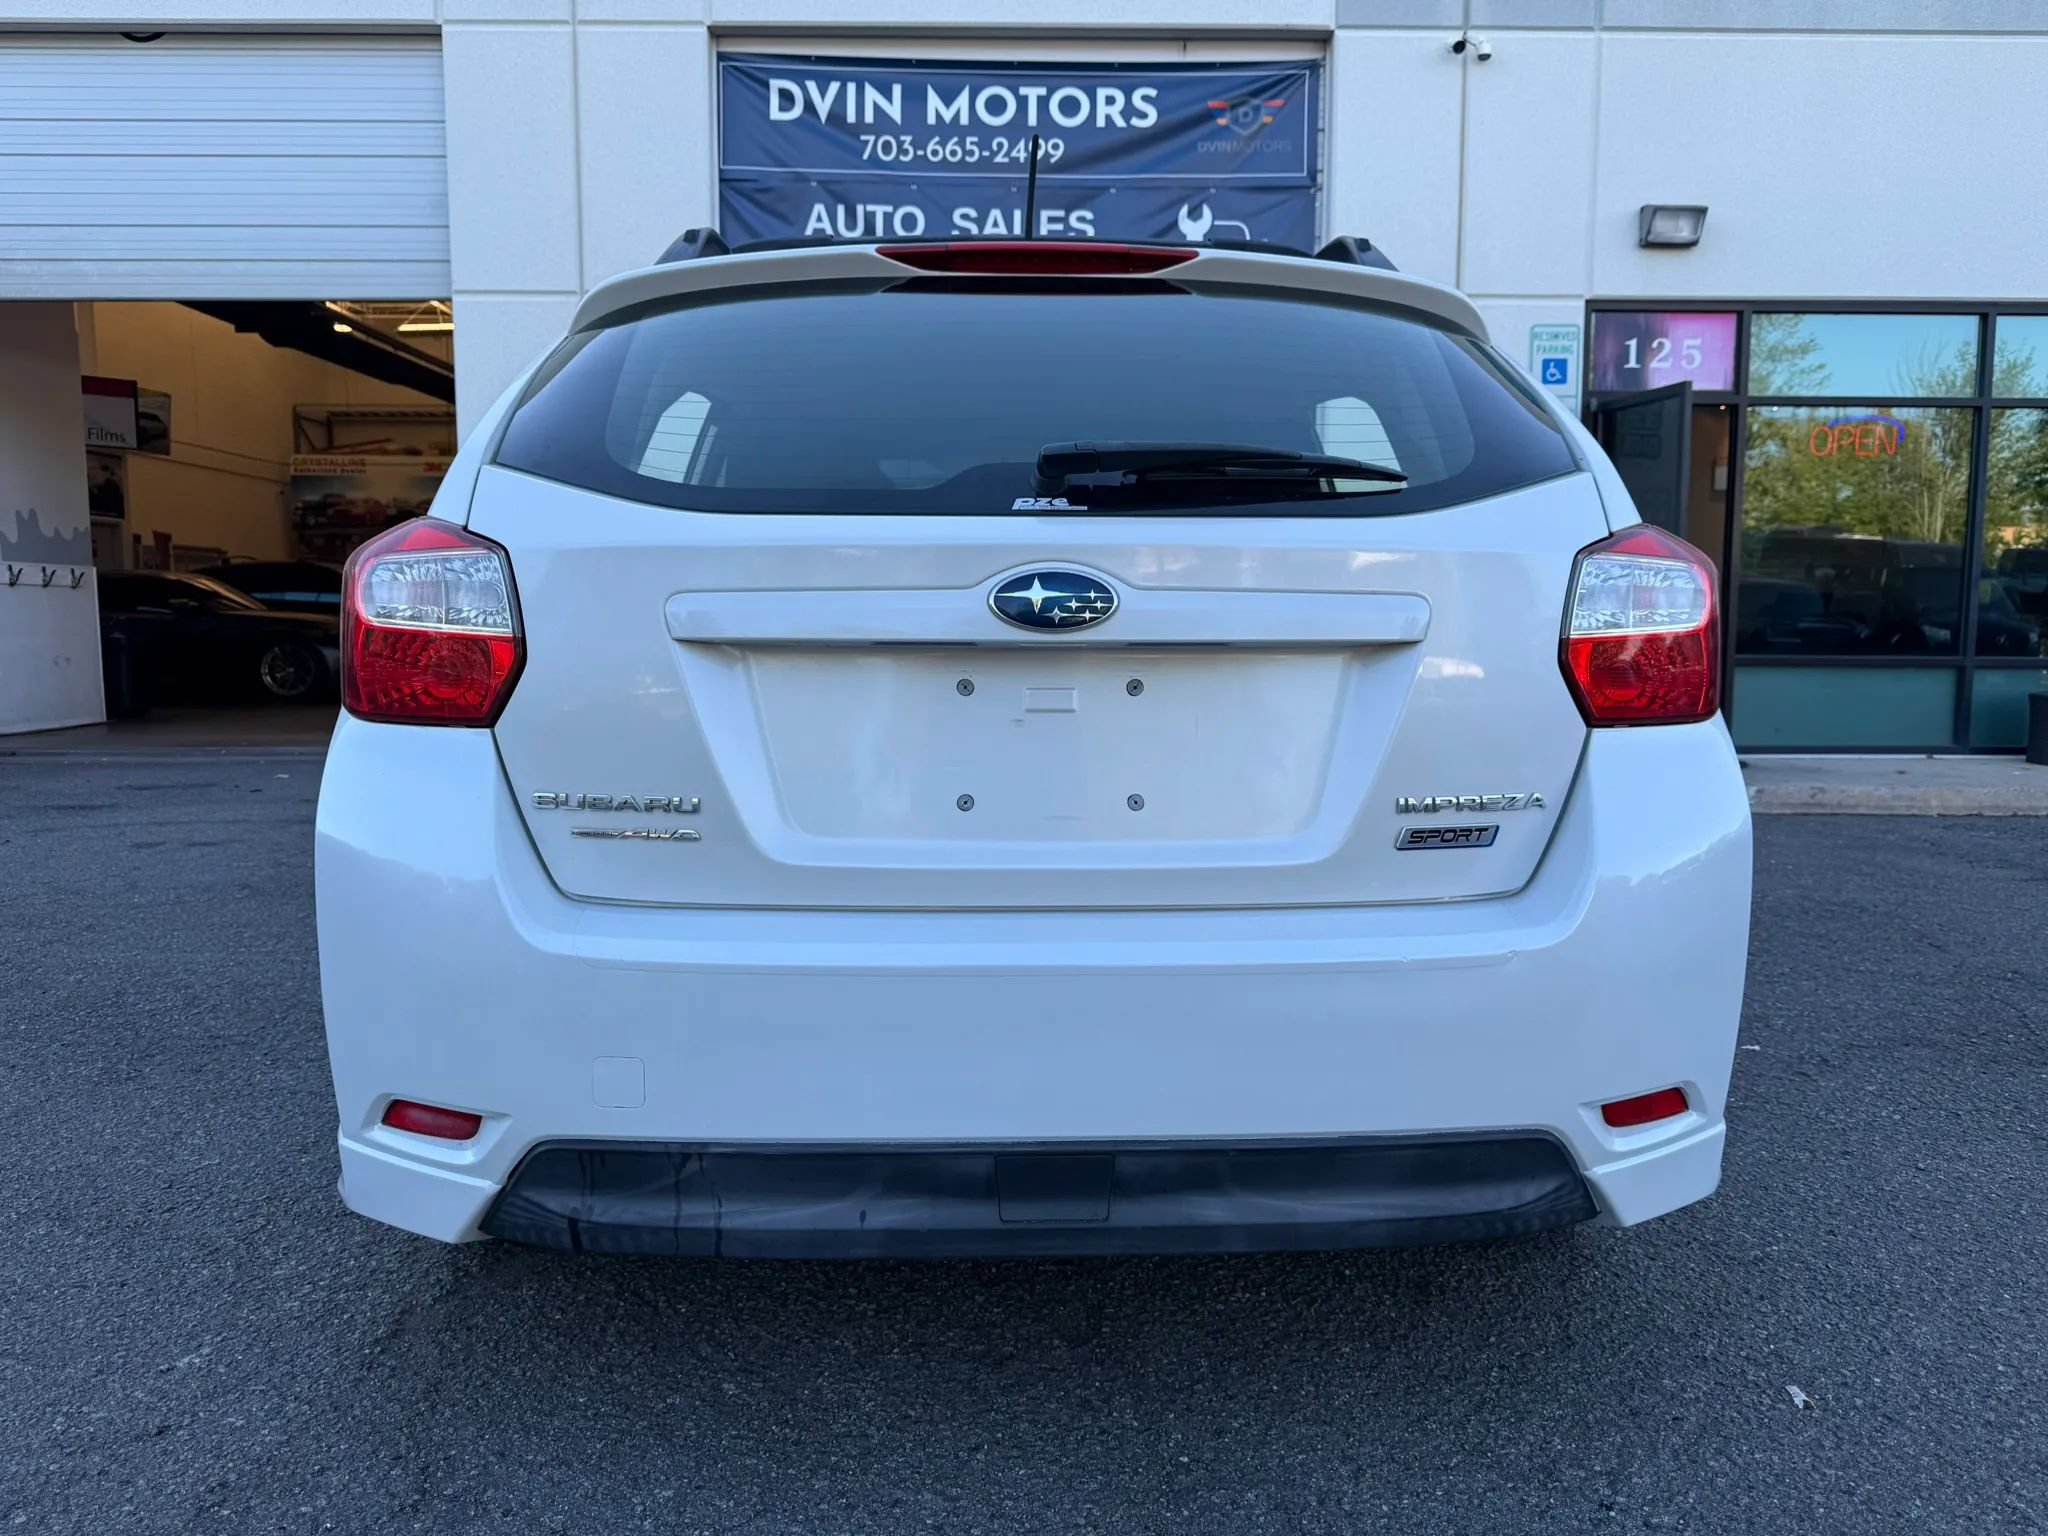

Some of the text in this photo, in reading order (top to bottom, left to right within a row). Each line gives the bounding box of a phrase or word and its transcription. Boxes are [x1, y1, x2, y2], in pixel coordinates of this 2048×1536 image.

[768, 78, 1159, 129] DVIN MOTORS
[803, 202, 926, 238] AUTO
[1623, 337, 1703, 369] 125
[87, 427, 128, 443] Films
[1809, 425, 1899, 457] OPEN
[531, 791, 701, 814] SUBARU
[1396, 792, 1548, 815] IMPREZA
[616, 829, 702, 842] AWD
[1407, 827, 1490, 845] SPORT
